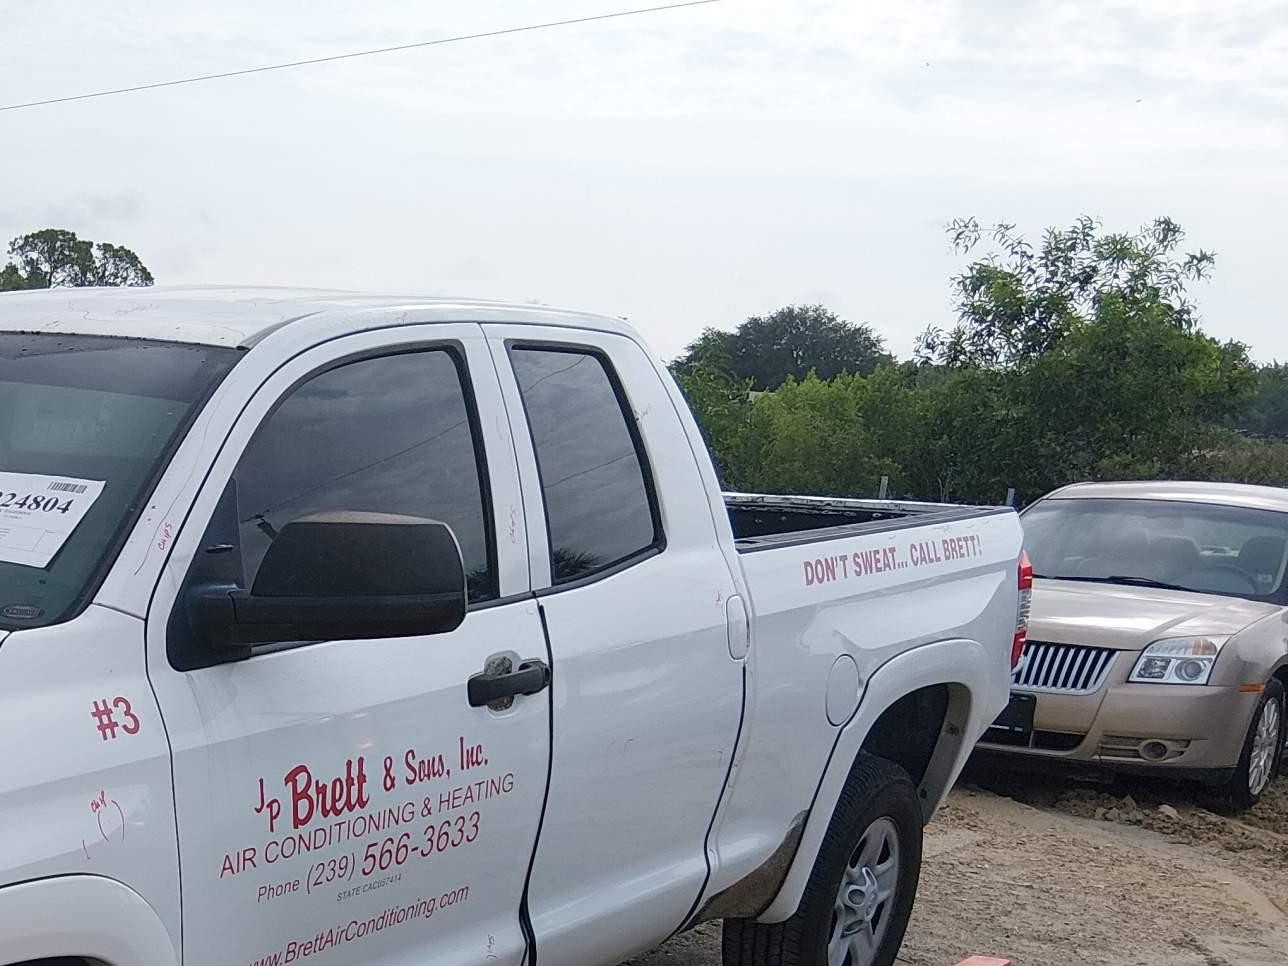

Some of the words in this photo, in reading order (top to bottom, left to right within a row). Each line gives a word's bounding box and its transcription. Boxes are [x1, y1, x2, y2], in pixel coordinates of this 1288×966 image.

[803, 554, 848, 586] DON'T
[852, 547, 909, 577] SWEAT...
[910, 541, 941, 567] CALL
[942, 534, 983, 561] BRETT!
[91, 697, 140, 740] #3
[284, 756, 370, 829] Brett
[383, 756, 396, 791] &
[405, 749, 451, 786] Sons,
[459, 736, 489, 772] Inc.
[219, 847, 257, 879] AIR
[264, 801, 416, 864] CONDITIONING
[421, 796, 432, 818] &
[438, 773, 514, 813] HEATING
[257, 878, 300, 903] Phone
[306, 853, 357, 894] (239)
[361, 811, 481, 877] 566-3633
[336, 886, 361, 902] STATE
